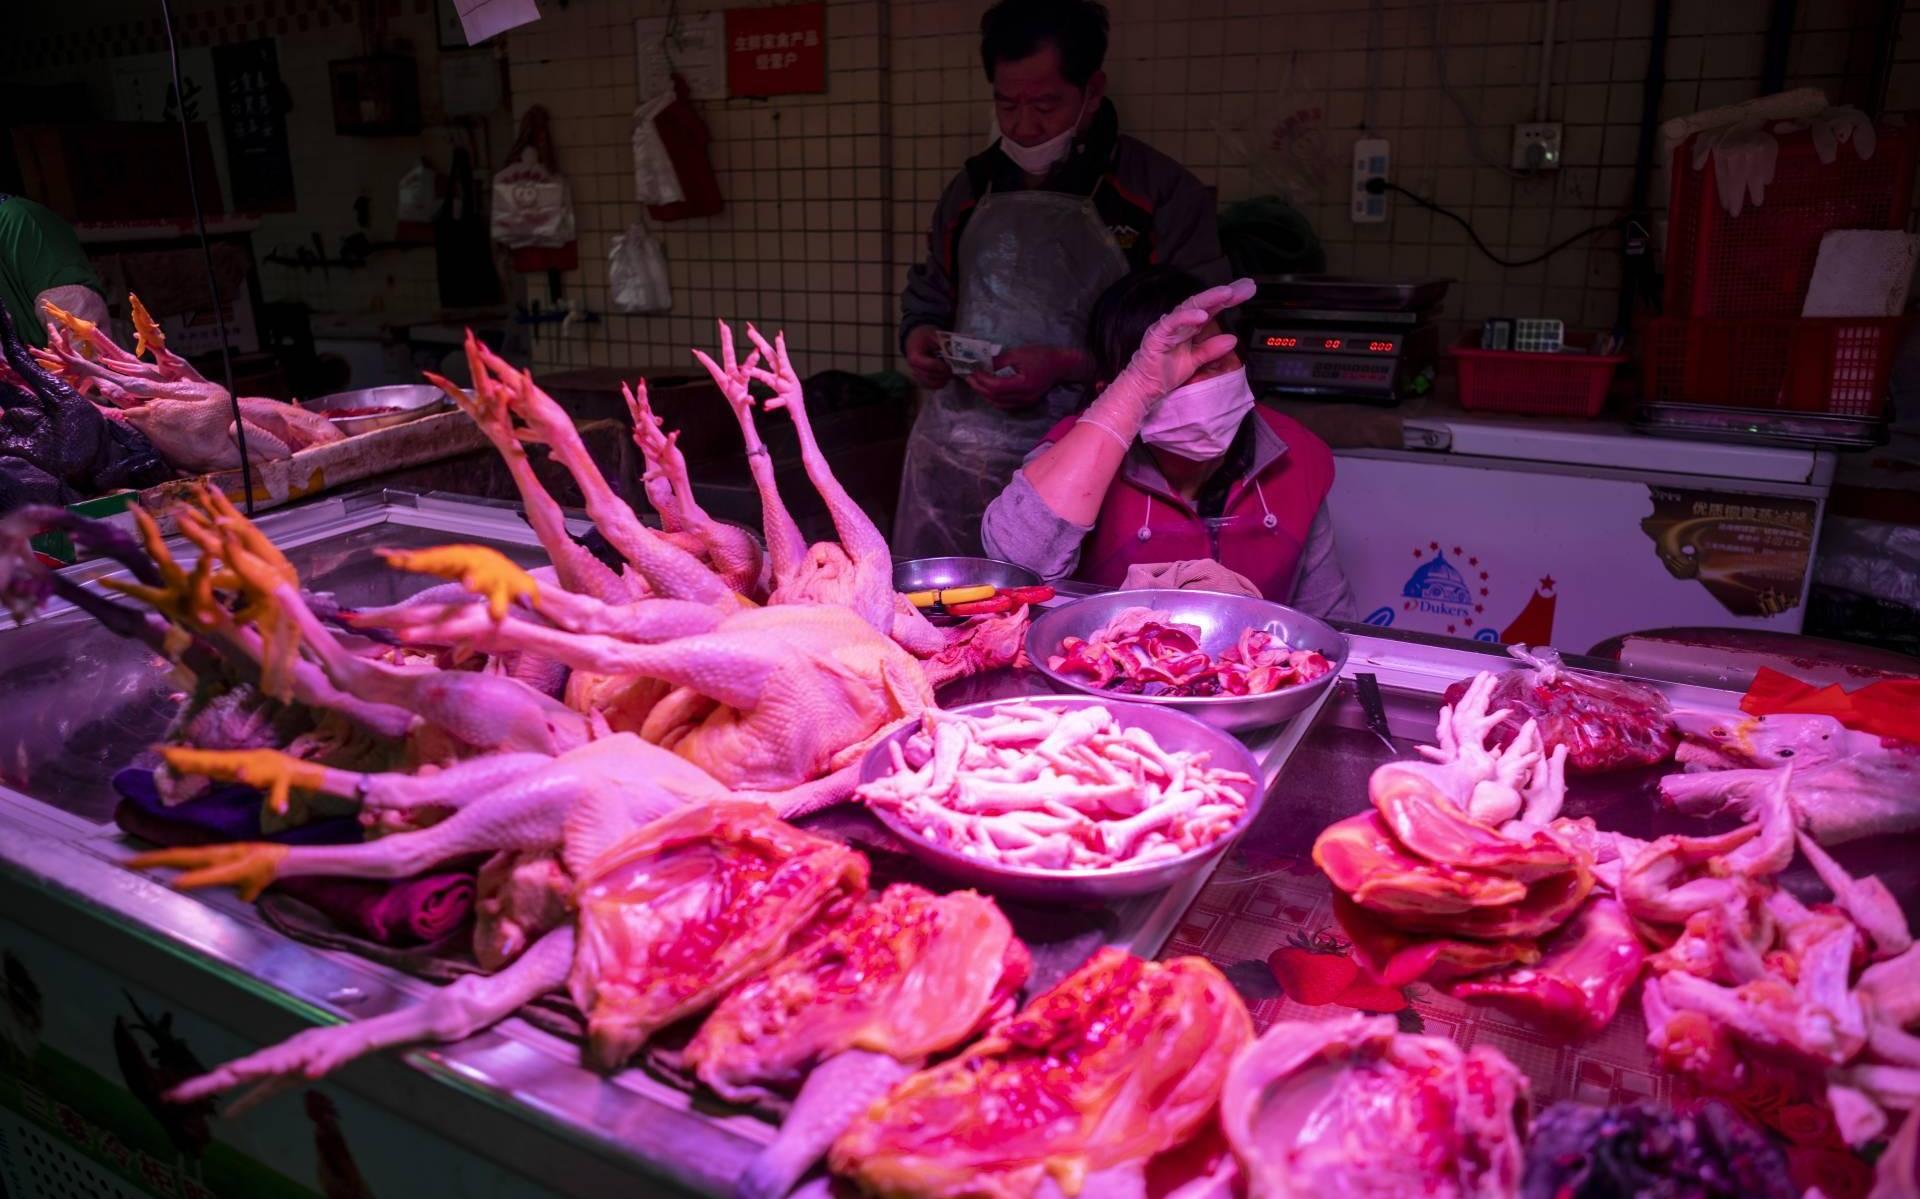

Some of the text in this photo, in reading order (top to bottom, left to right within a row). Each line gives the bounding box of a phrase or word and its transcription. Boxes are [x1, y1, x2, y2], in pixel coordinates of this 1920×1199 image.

[755, 51, 799, 70] 经营户
[1420, 600, 1470, 617] Dukers
